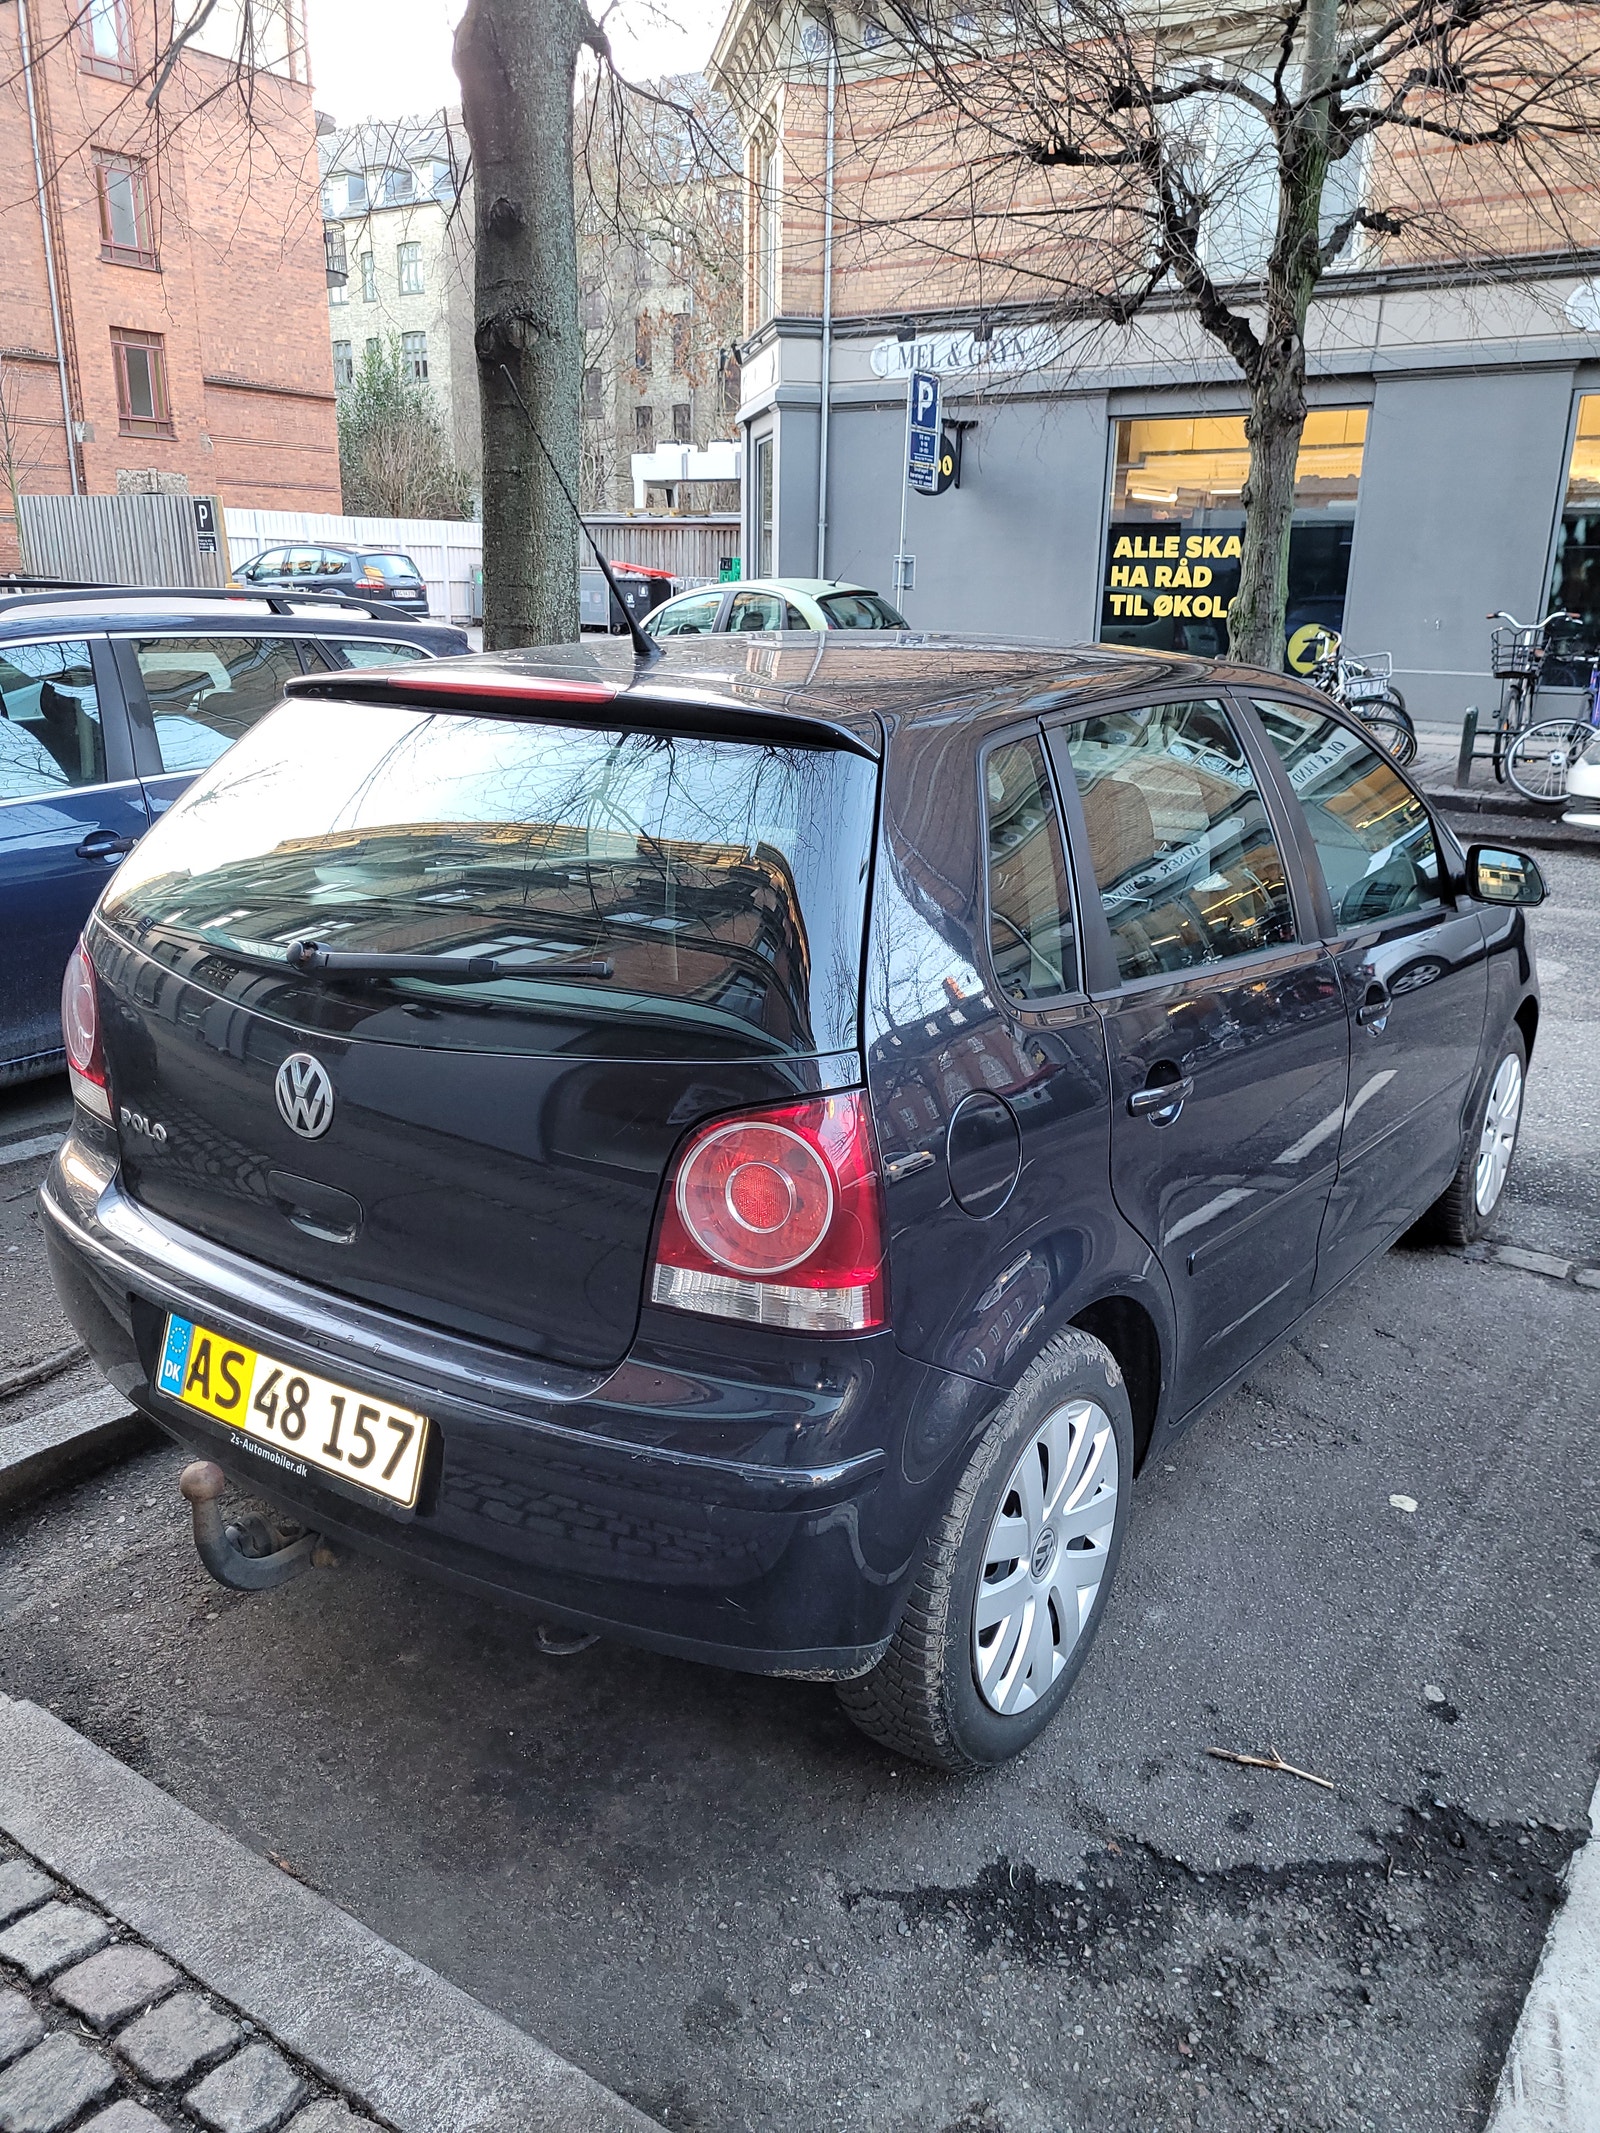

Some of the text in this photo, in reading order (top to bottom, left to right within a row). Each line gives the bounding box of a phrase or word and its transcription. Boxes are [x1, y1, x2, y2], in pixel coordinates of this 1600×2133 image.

[898, 343, 941, 370] MEL
[947, 341, 962, 367] &
[917, 380, 934, 421] P
[198, 504, 208, 528] P
[1113, 536, 1181, 559] ALLE
[1110, 558, 1213, 588] HA RÅD
[1110, 594, 1238, 618] TIL ØKOL
[120, 1106, 167, 1143] POLO
[164, 1359, 181, 1382] DK
[185, 1338, 415, 1481] AS 48 157
